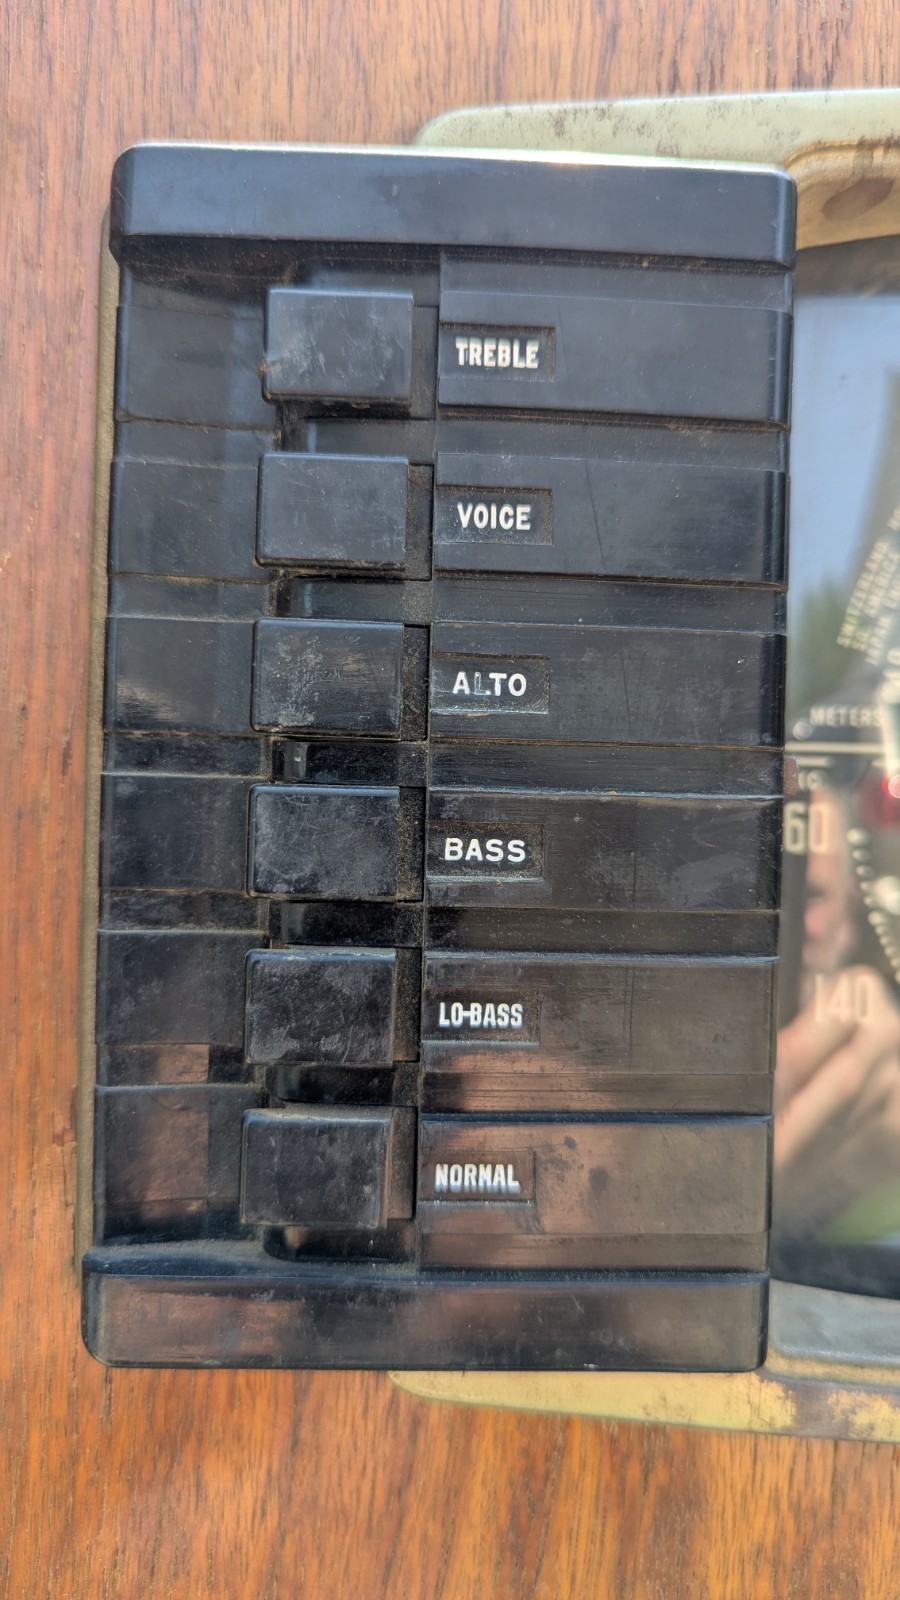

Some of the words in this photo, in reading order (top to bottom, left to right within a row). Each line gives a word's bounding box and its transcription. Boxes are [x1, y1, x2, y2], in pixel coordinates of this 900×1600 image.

[455, 336, 540, 369] TREBLE
[457, 502, 531, 530] VOICE
[452, 671, 527, 696] ALTO
[810, 706, 881, 727] METERS
[444, 837, 526, 862] BASS
[438, 1002, 523, 1028] LO-BASS
[434, 1163, 521, 1194] NORMAL
